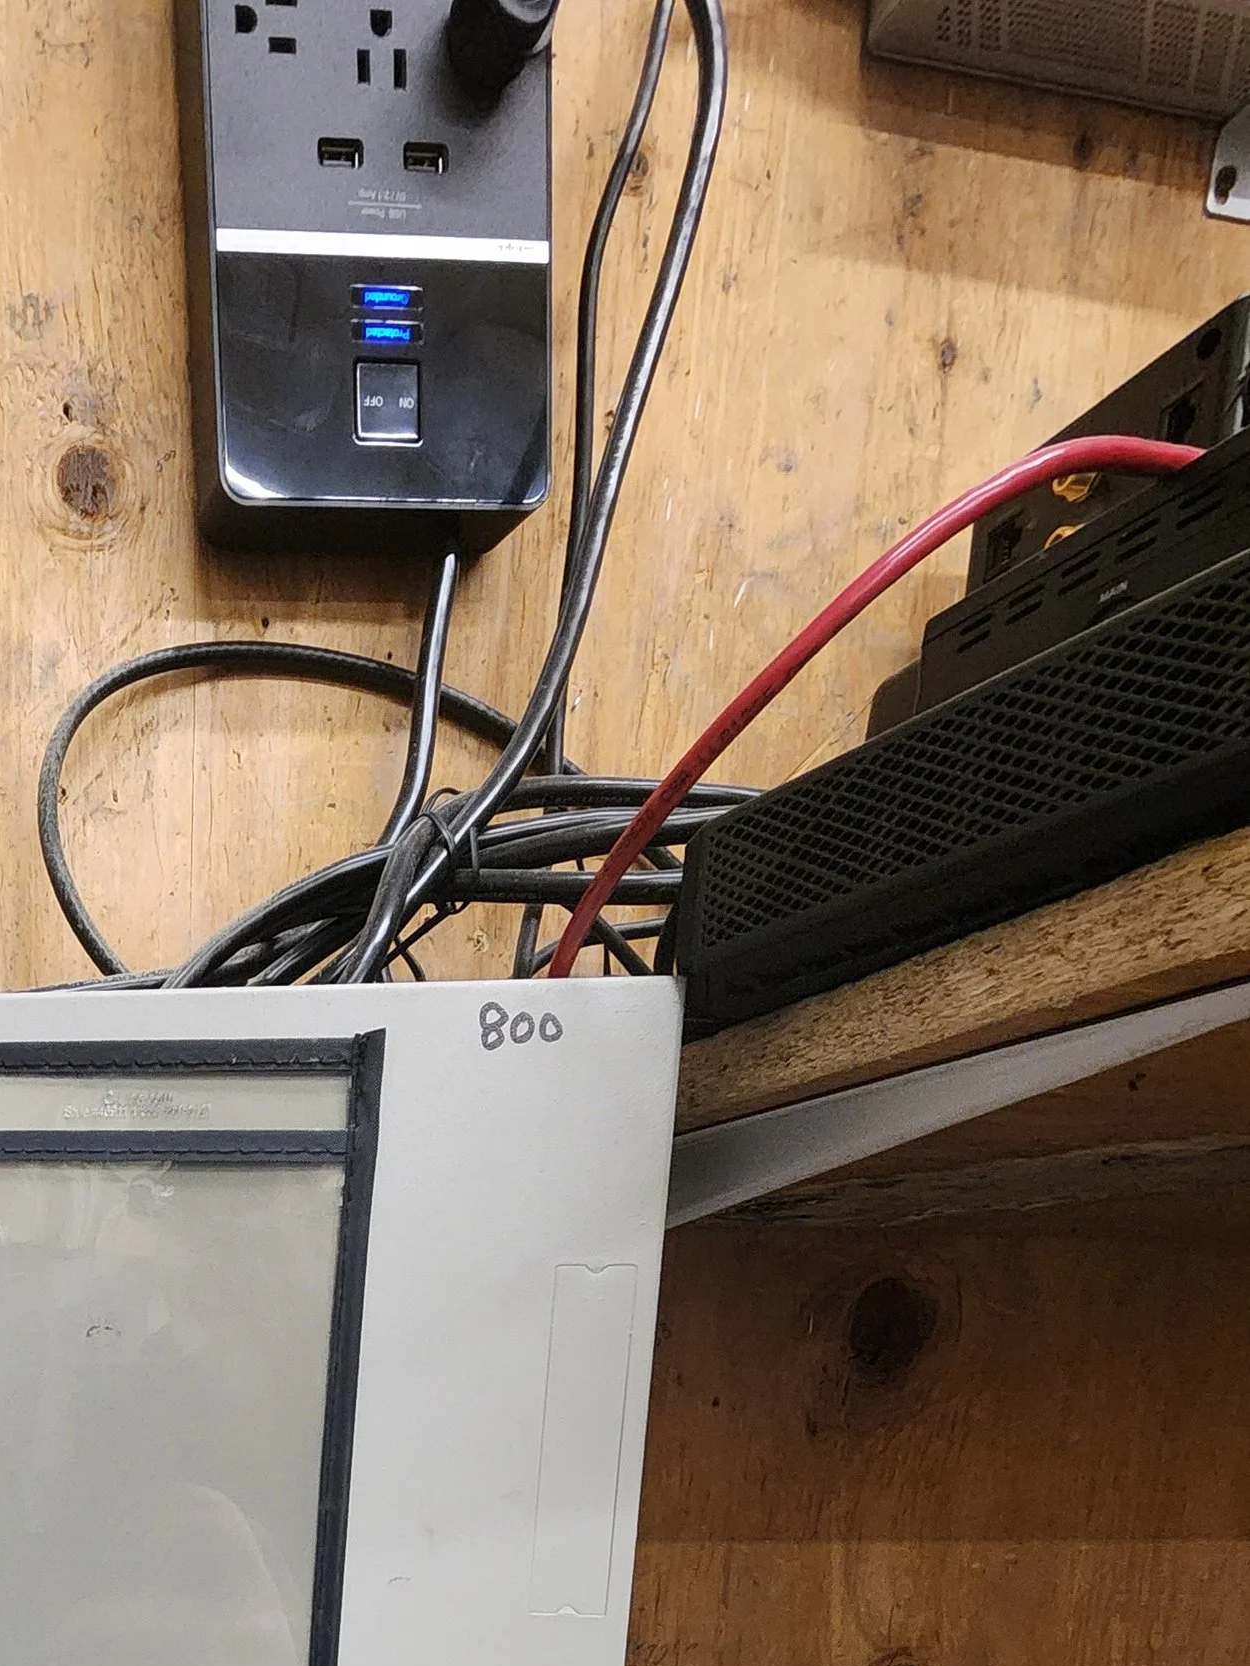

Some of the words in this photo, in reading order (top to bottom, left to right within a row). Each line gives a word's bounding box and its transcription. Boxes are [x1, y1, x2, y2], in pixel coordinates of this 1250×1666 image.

[364, 291, 410, 305] Grounded
[365, 327, 410, 340] Protected
[363, 394, 384, 407] OFF
[398, 396, 415, 409] ON
[479, 1001, 564, 1052] 800
